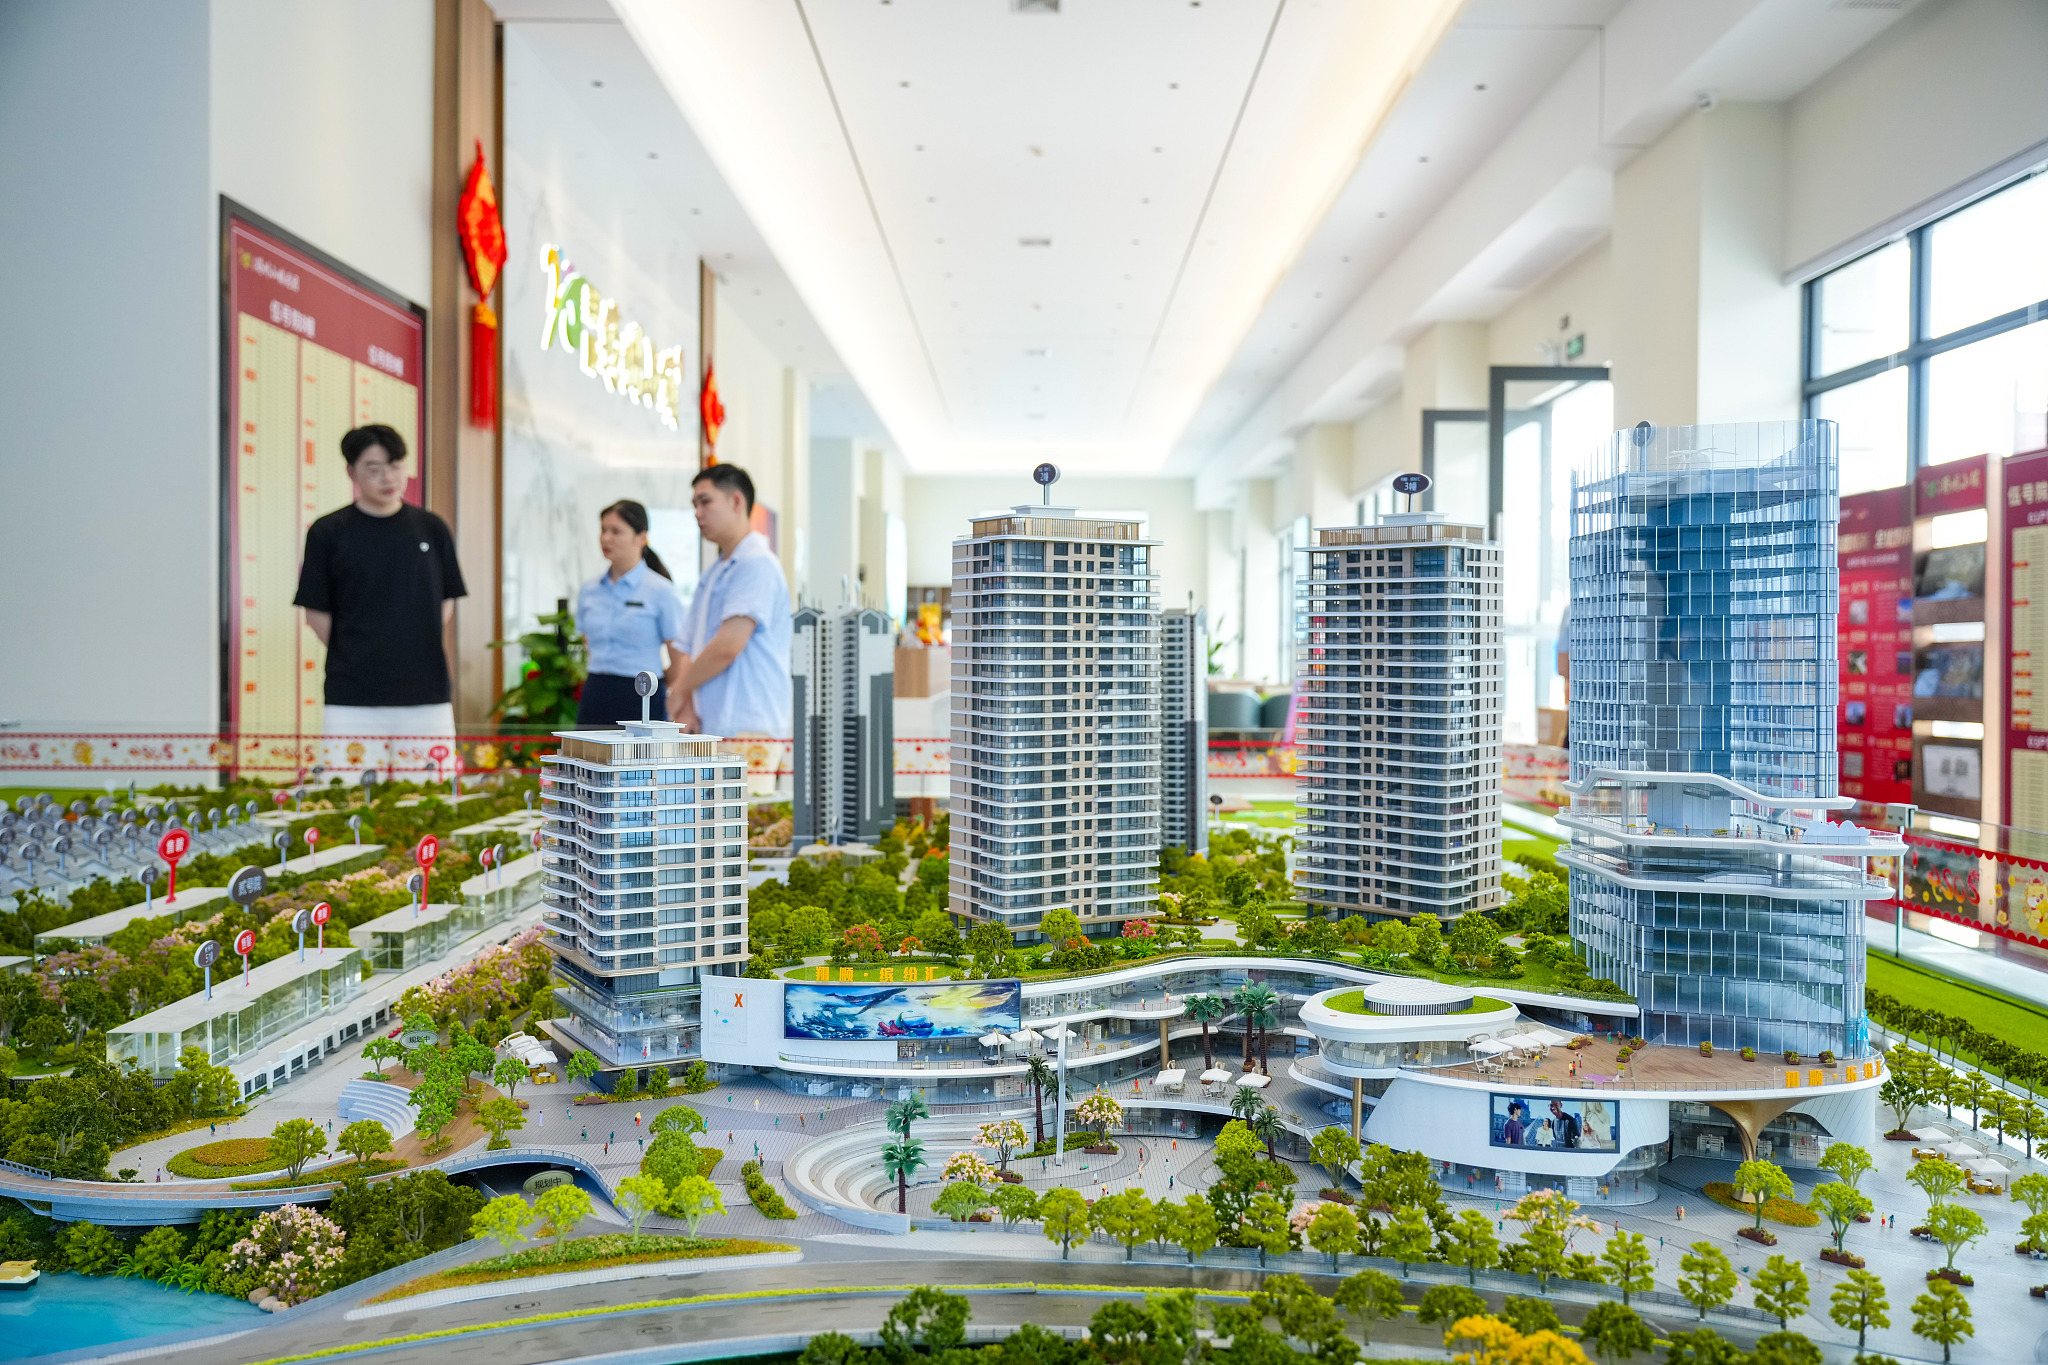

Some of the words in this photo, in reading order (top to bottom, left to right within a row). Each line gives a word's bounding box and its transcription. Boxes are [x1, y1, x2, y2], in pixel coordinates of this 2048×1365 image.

[815, 966, 940, 982] 翔顺·缤纷汇
[408, 1034, 431, 1044] 规划中
[534, 1176, 562, 1190] 规划中
